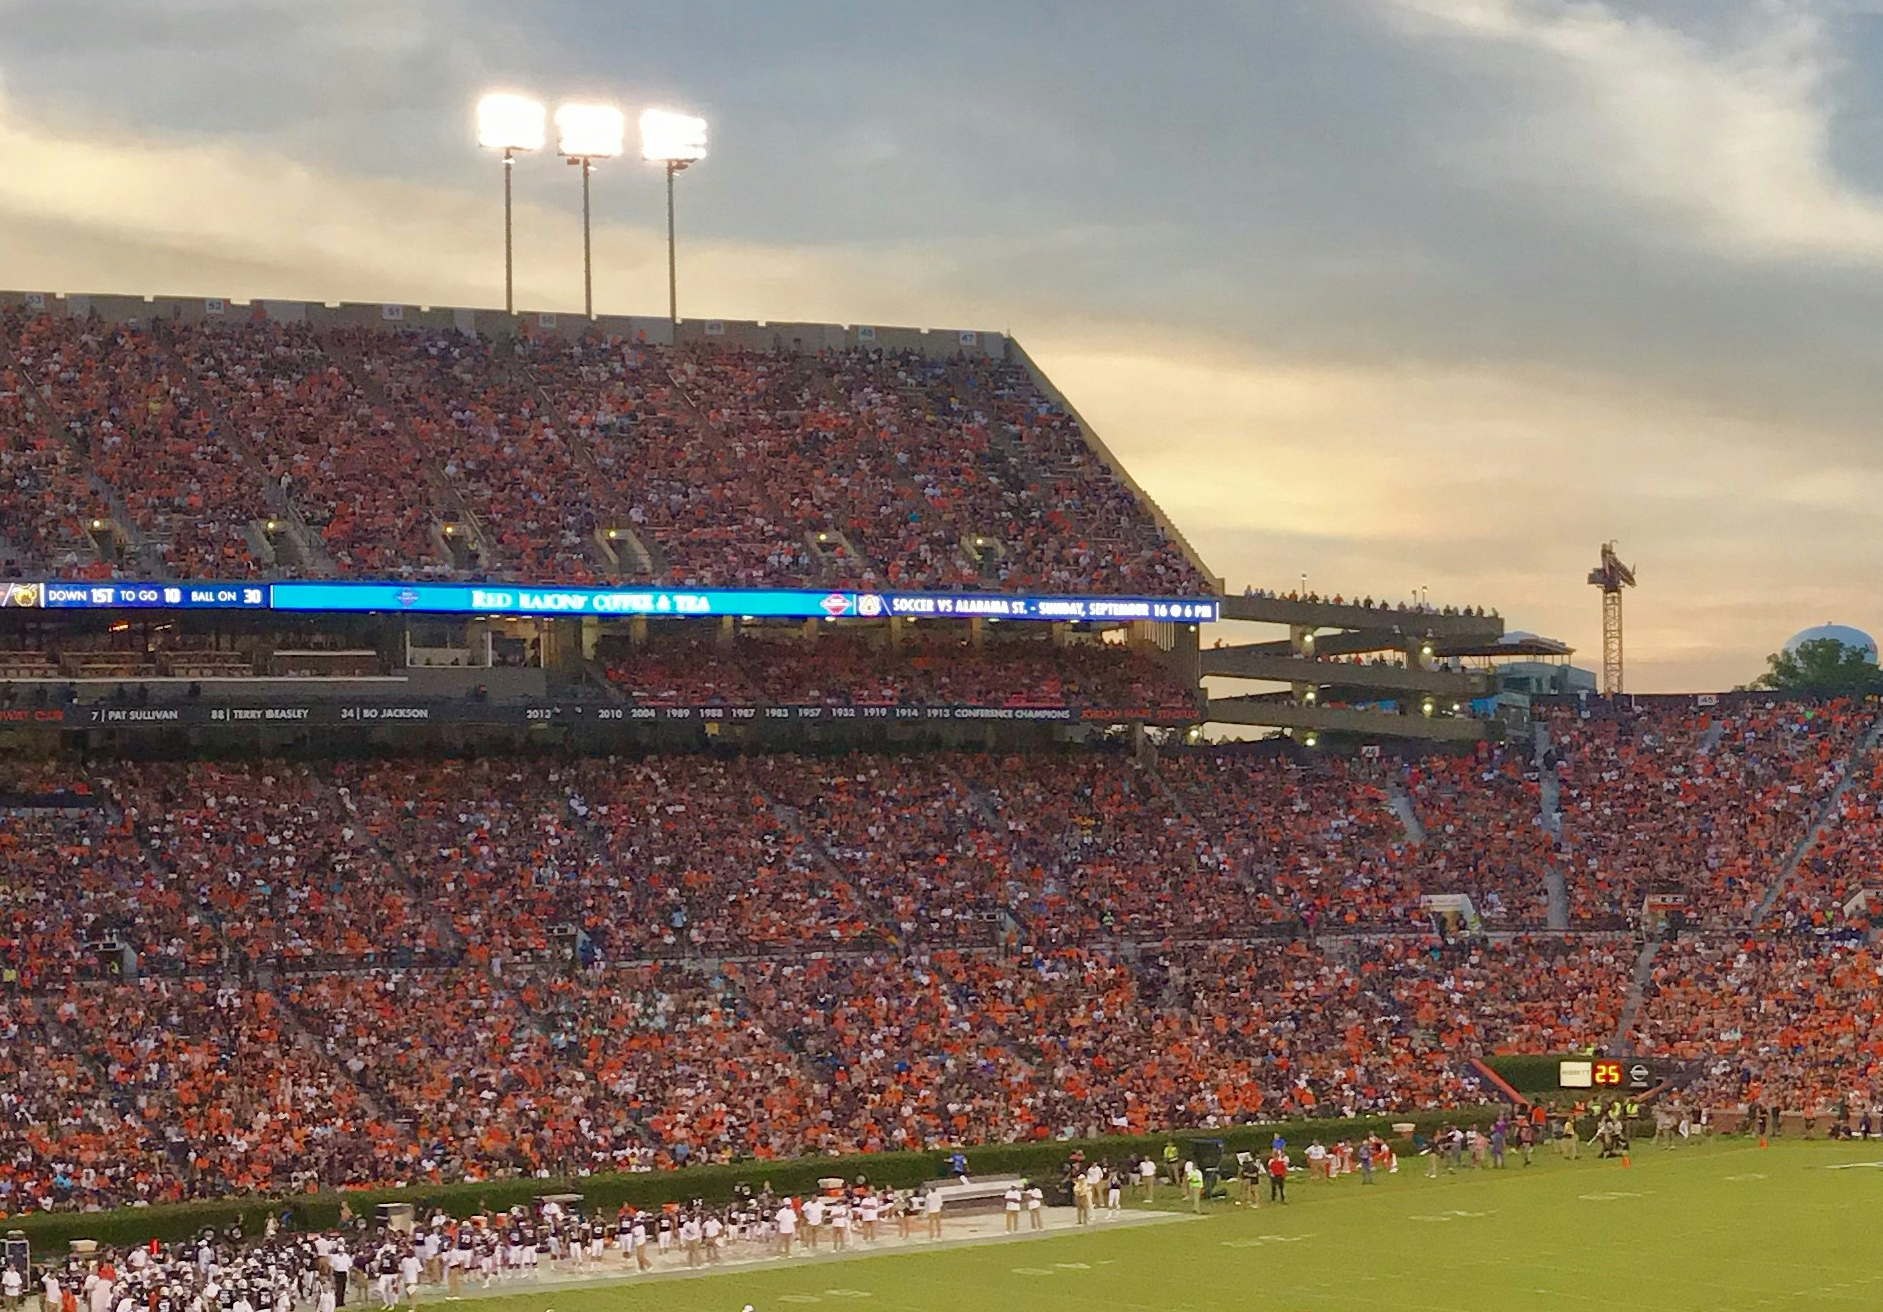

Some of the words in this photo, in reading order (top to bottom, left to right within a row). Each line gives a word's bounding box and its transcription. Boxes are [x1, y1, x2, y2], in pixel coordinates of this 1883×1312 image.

[48, 590, 85, 602] DOWN
[91, 588, 114, 604] 1ST
[120, 590, 135, 602] TO
[138, 590, 158, 602] GO
[163, 588, 181, 604] 10
[191, 591, 215, 602] BALL
[218, 591, 236, 602] ON
[243, 588, 262, 604] 30
[892, 598, 934, 613] SOCCER
[937, 599, 953, 613] VS
[955, 600, 1010, 614] ALABAMA
[1011, 601, 1028, 615] ST.
[1039, 601, 1085, 617] SUNDAY,
[1089, 602, 1149, 616] SEPTEMBER
[1154, 604, 1168, 617] 16
[1170, 604, 1182, 617] @
[1185, 604, 1192, 617] 6
[1195, 605, 1211, 618] PM
[108, 710, 126, 721] PAT
[129, 709, 179, 721] SULLIVAN
[233, 709, 262, 720] TERRY
[265, 708, 309, 720] BEASLEY
[340, 708, 354, 719] 34
[363, 708, 378, 719] BO
[380, 707, 429, 719] JACKSON
[598, 708, 624, 719] 2010
[895, 707, 919, 718] 1914
[926, 708, 951, 718] 1913
[954, 708, 1013, 720] CONFERENCE
[1015, 708, 1071, 720] CHAMPIONS
[1595, 1064, 1620, 1084] 25
